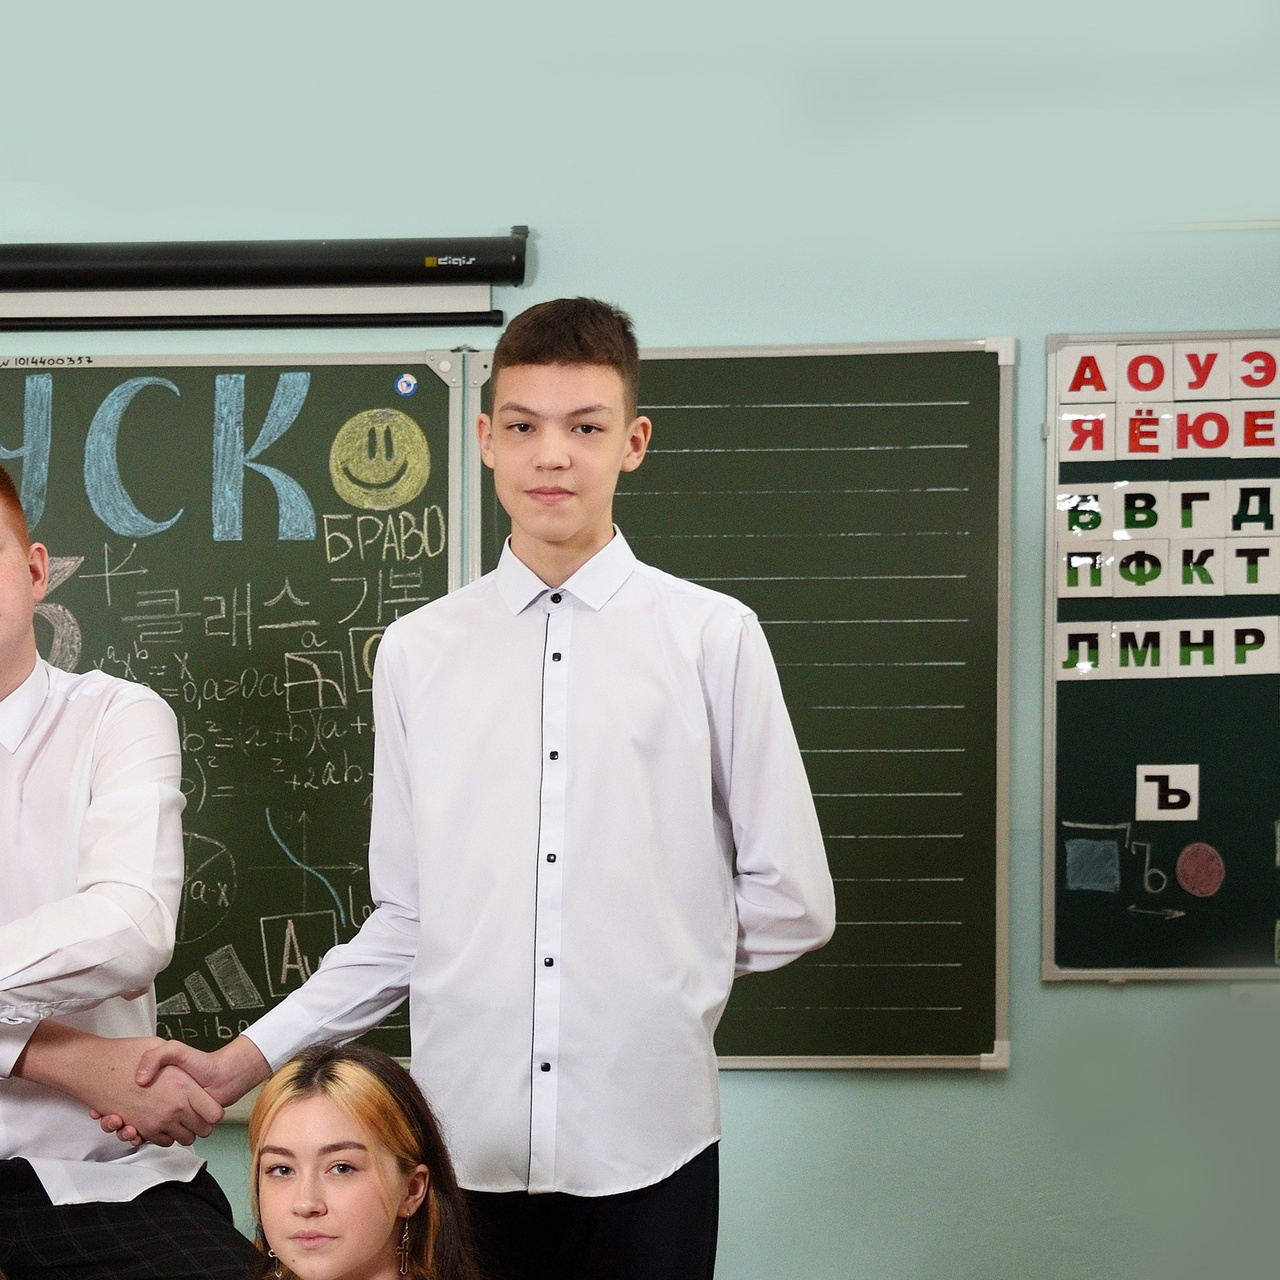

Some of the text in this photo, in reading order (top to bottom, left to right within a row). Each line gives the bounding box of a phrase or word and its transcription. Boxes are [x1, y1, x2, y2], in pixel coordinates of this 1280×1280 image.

[438, 256, 476, 266] digis
[1068, 351, 1277, 392] А О У Э
[1068, 409, 1276, 453] Я Ё Ю Е
[1124, 492, 1158, 529] В
[1181, 492, 1210, 528] Г
[1231, 487, 1274, 531] Д
[323, 505, 446, 563] БРАВО
[1067, 548, 1270, 587] П Ф К Т
[1062, 628, 1265, 669] Л М Н Р
[1144, 775, 1191, 810] Ъ
